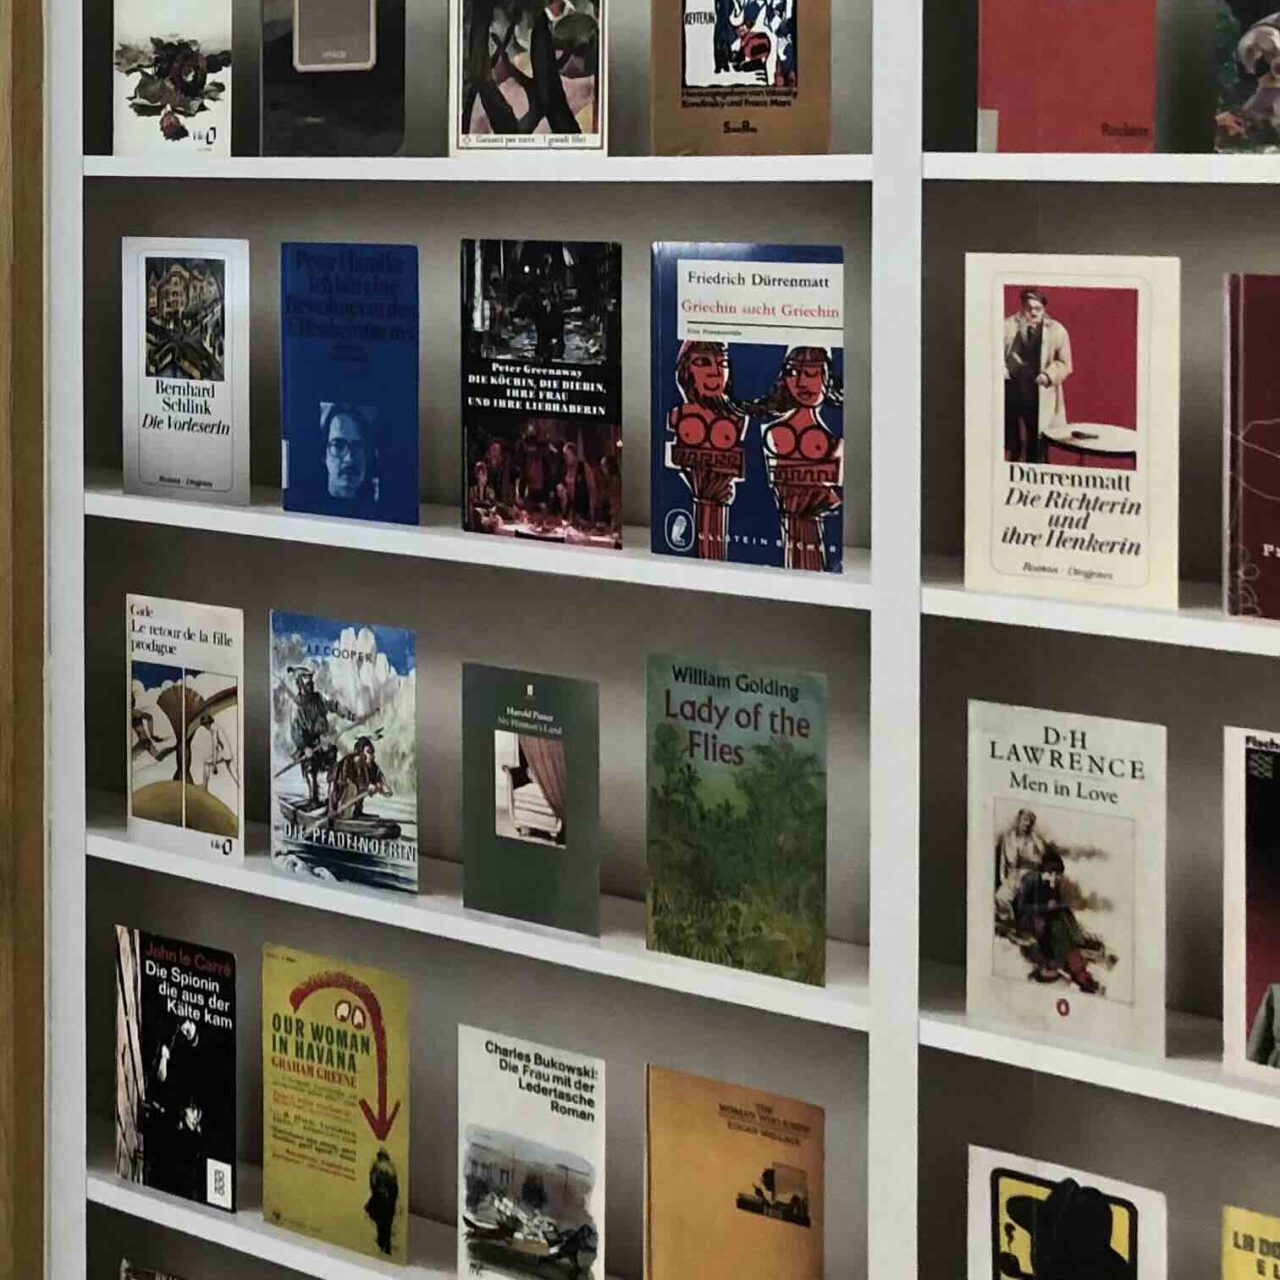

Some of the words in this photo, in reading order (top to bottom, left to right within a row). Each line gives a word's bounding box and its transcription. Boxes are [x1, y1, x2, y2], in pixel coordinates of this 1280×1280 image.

[687, 270, 746, 287] Friedrich
[751, 271, 830, 289] Dürrenmatt
[681, 299, 738, 316] Griechin
[740, 302, 777, 317] sucht
[780, 303, 840, 319] Griechin
[492, 362, 521, 376] Peter
[523, 364, 583, 379] Greenaway
[156, 380, 215, 399] Bernhard
[162, 397, 212, 416] Schlink
[526, 400, 606, 416] LIEBHABERIN
[1009, 464, 1130, 492] Dürrenmatt
[1004, 487, 1042, 509] Die
[1044, 491, 1142, 516] Richterin
[1047, 512, 1090, 530] und
[1001, 529, 1042, 548] ihre
[1046, 530, 1141, 557] Henkerin
[200, 627, 208, 643] la
[672, 664, 730, 690] William
[736, 673, 800, 702] Golding
[664, 689, 730, 730] Lady
[734, 704, 761, 731] of
[769, 709, 811, 739] the
[688, 731, 745, 767] Flies
[990, 741, 1145, 780] LAWRENCE
[1009, 771, 1048, 794] Men
[1054, 778, 1070, 797] in
[1076, 781, 1118, 805] Love
[312, 826, 416, 863] PFADFINDERIN
[180, 949, 190, 966] le
[145, 960, 167, 978] Die
[171, 967, 219, 993] Spionin
[159, 981, 177, 998] die
[182, 990, 204, 1006] aus
[208, 994, 230, 1012] der
[167, 998, 200, 1020] Kälte
[205, 1008, 232, 1029] kam
[272, 1014, 304, 1038] OUR
[311, 1022, 370, 1055] WOMAN
[271, 1056, 314, 1078] GRAHAM
[272, 1034, 288, 1055] IN
[295, 1040, 356, 1072] HAVANA
[485, 1040, 530, 1063] Charles
[534, 1052, 599, 1081] Bukowski:
[499, 1058, 519, 1074] Die
[523, 1065, 550, 1082] Frau
[574, 1078, 595, 1095] der
[519, 1079, 595, 1109] Ledertasche
[550, 1100, 595, 1123] Roman
